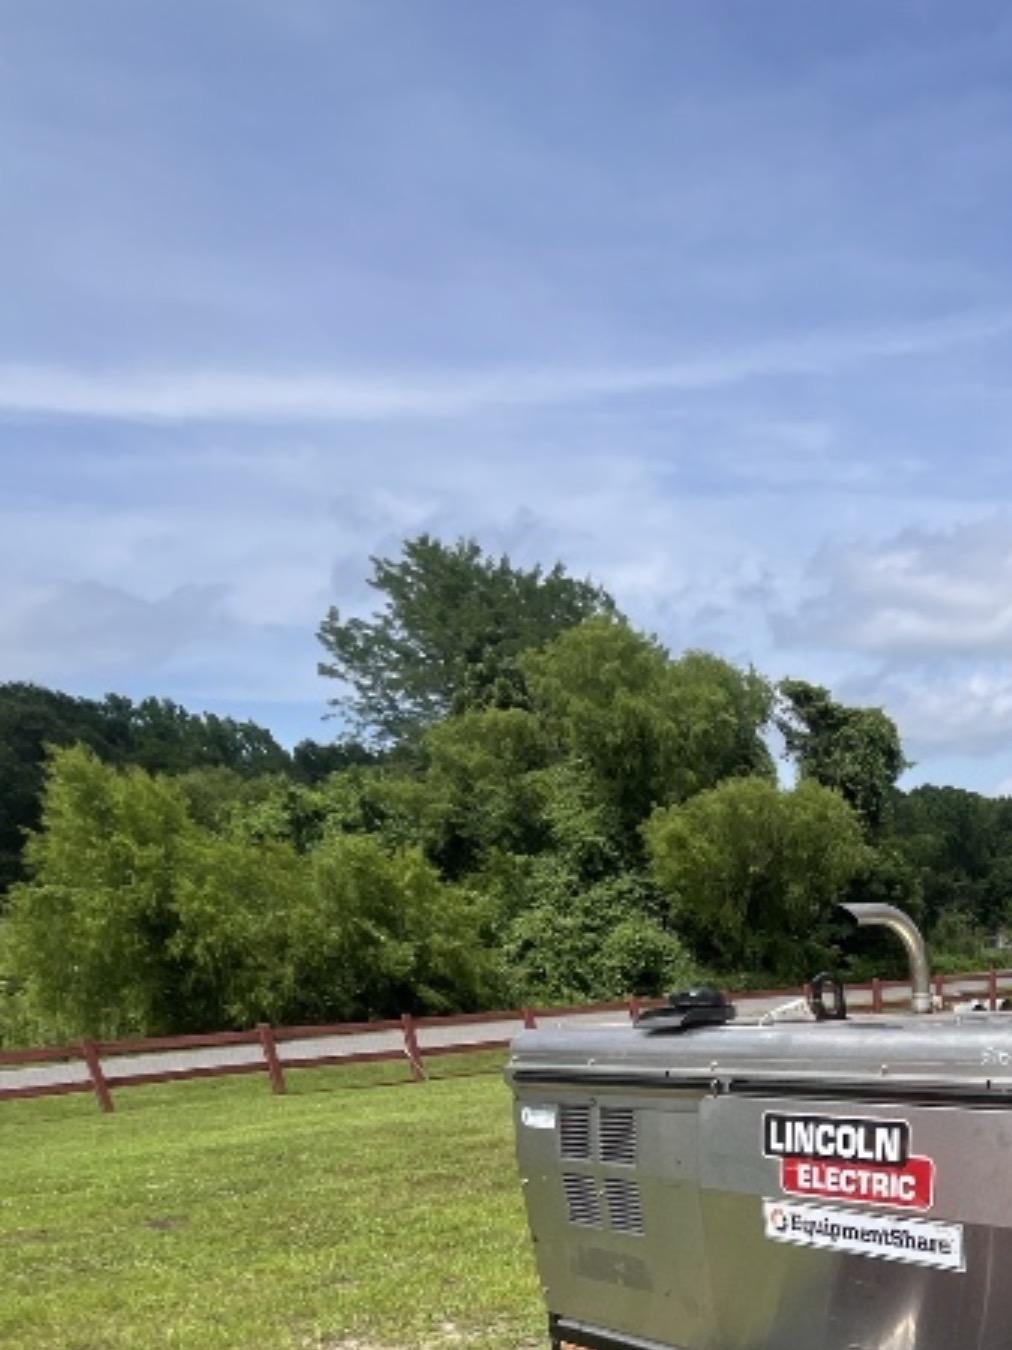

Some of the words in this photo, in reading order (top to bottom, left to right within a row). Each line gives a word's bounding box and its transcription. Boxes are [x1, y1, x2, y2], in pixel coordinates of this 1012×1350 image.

[769, 1119, 901, 1162] LINCOLN
[797, 1163, 916, 1200] ELECTRIC
[791, 1213, 953, 1255] EquipmentShare
